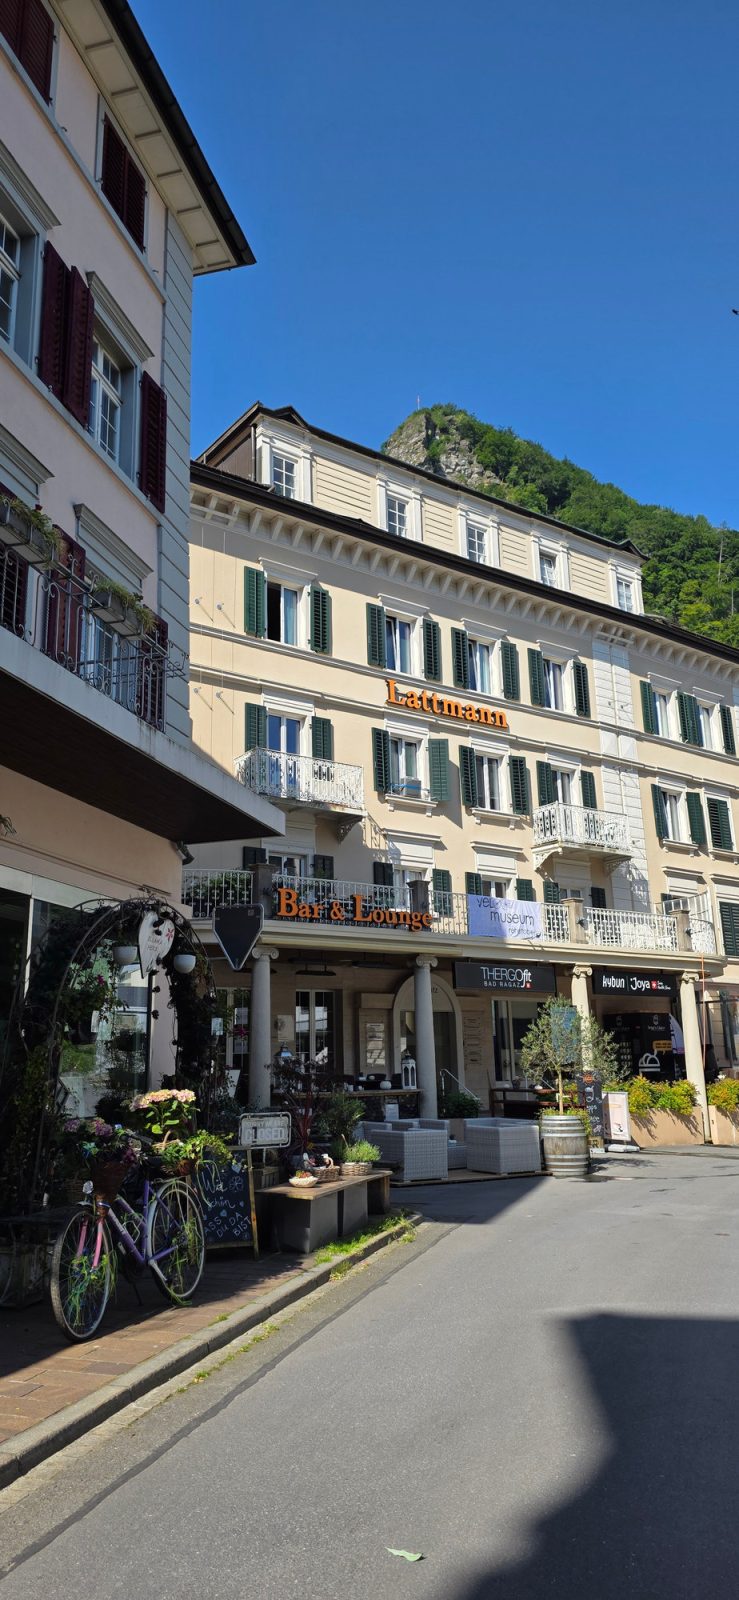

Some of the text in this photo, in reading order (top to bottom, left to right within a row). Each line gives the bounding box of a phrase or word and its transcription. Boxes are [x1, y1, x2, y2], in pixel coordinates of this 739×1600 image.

[385, 679, 509, 729] Lattmann
[277, 887, 433, 932] Bar & Lounge
[490, 911, 535, 926] museum
[602, 975, 625, 989] kybun
[630, 976, 651, 992] Joya
[244, 1127, 285, 1142] CLOSED
[233, 1215, 252, 1237] BIST
